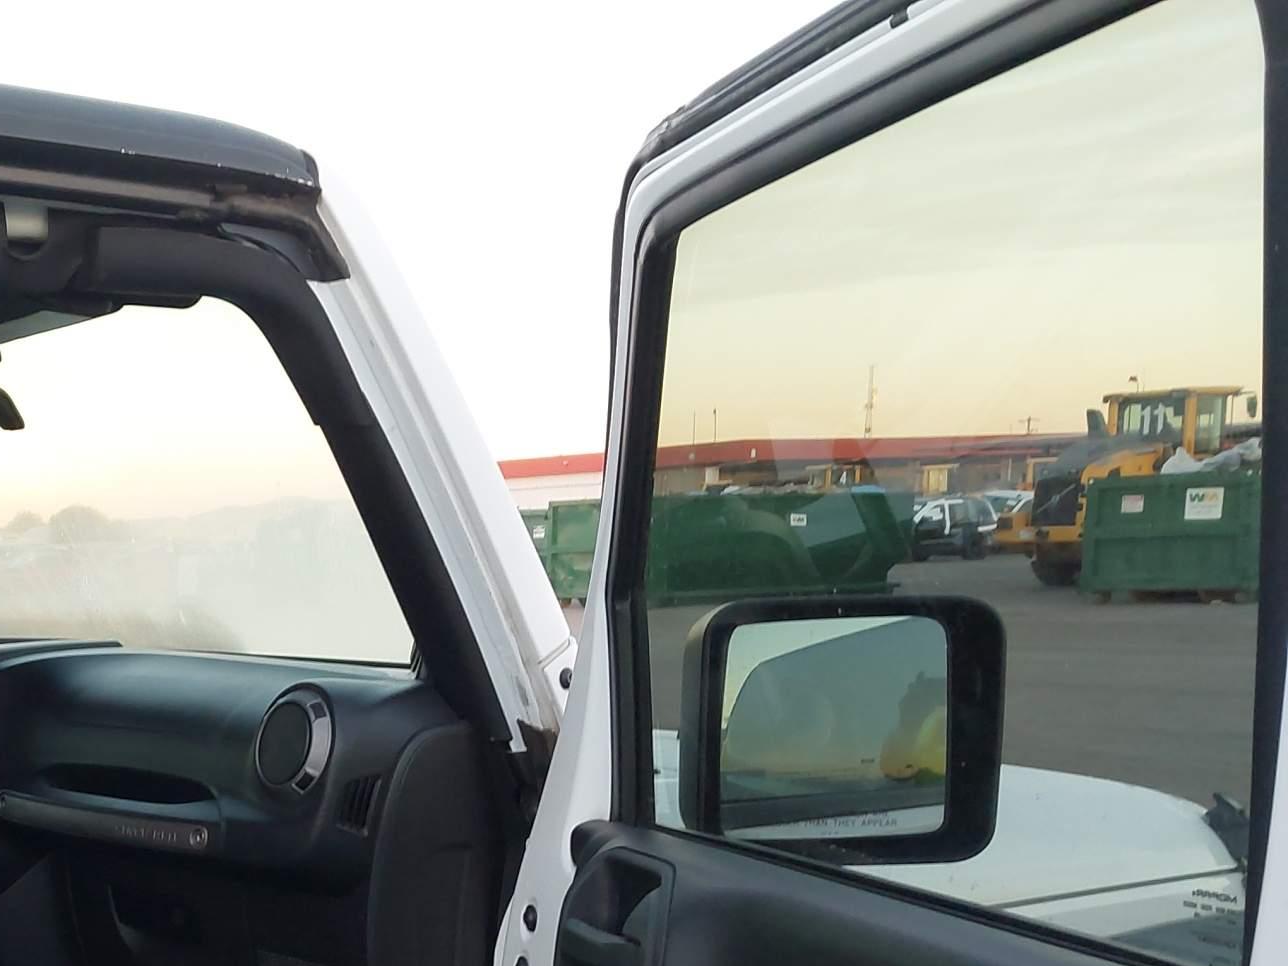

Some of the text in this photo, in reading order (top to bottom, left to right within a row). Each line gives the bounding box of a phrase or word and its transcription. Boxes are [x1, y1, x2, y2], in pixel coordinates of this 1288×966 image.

[1142, 402, 1165, 435] 11
[833, 818, 856, 827] THEY
[861, 817, 898, 827] APPEAR
